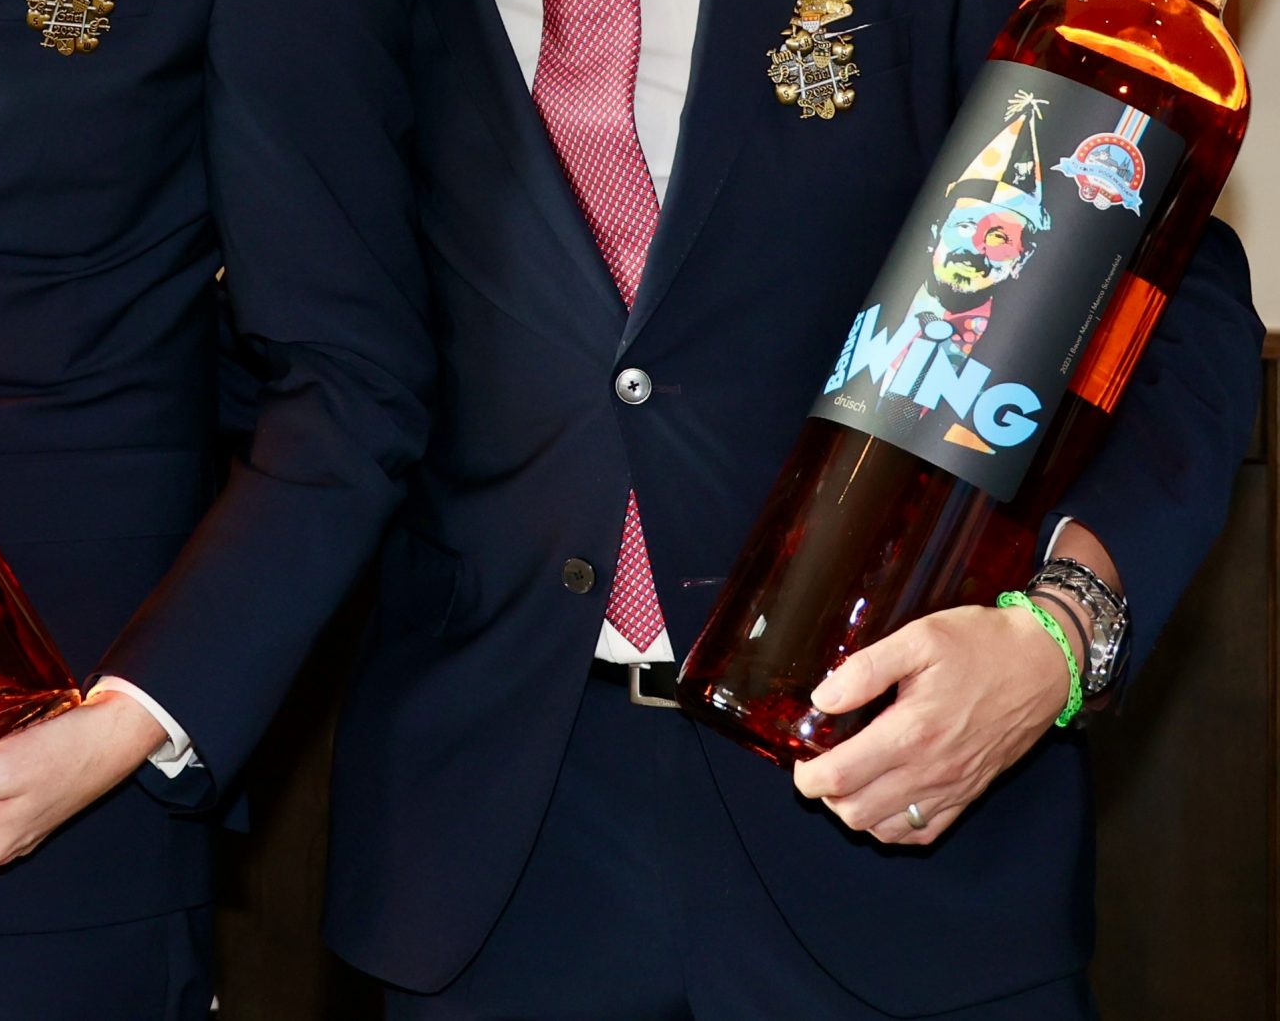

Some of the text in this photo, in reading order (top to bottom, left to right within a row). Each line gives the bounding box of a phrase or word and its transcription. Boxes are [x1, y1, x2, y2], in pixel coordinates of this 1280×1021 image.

[1060, 357, 1072, 375] 2023
[1079, 314, 1093, 334] Marco
[1091, 290, 1105, 311] Marco
